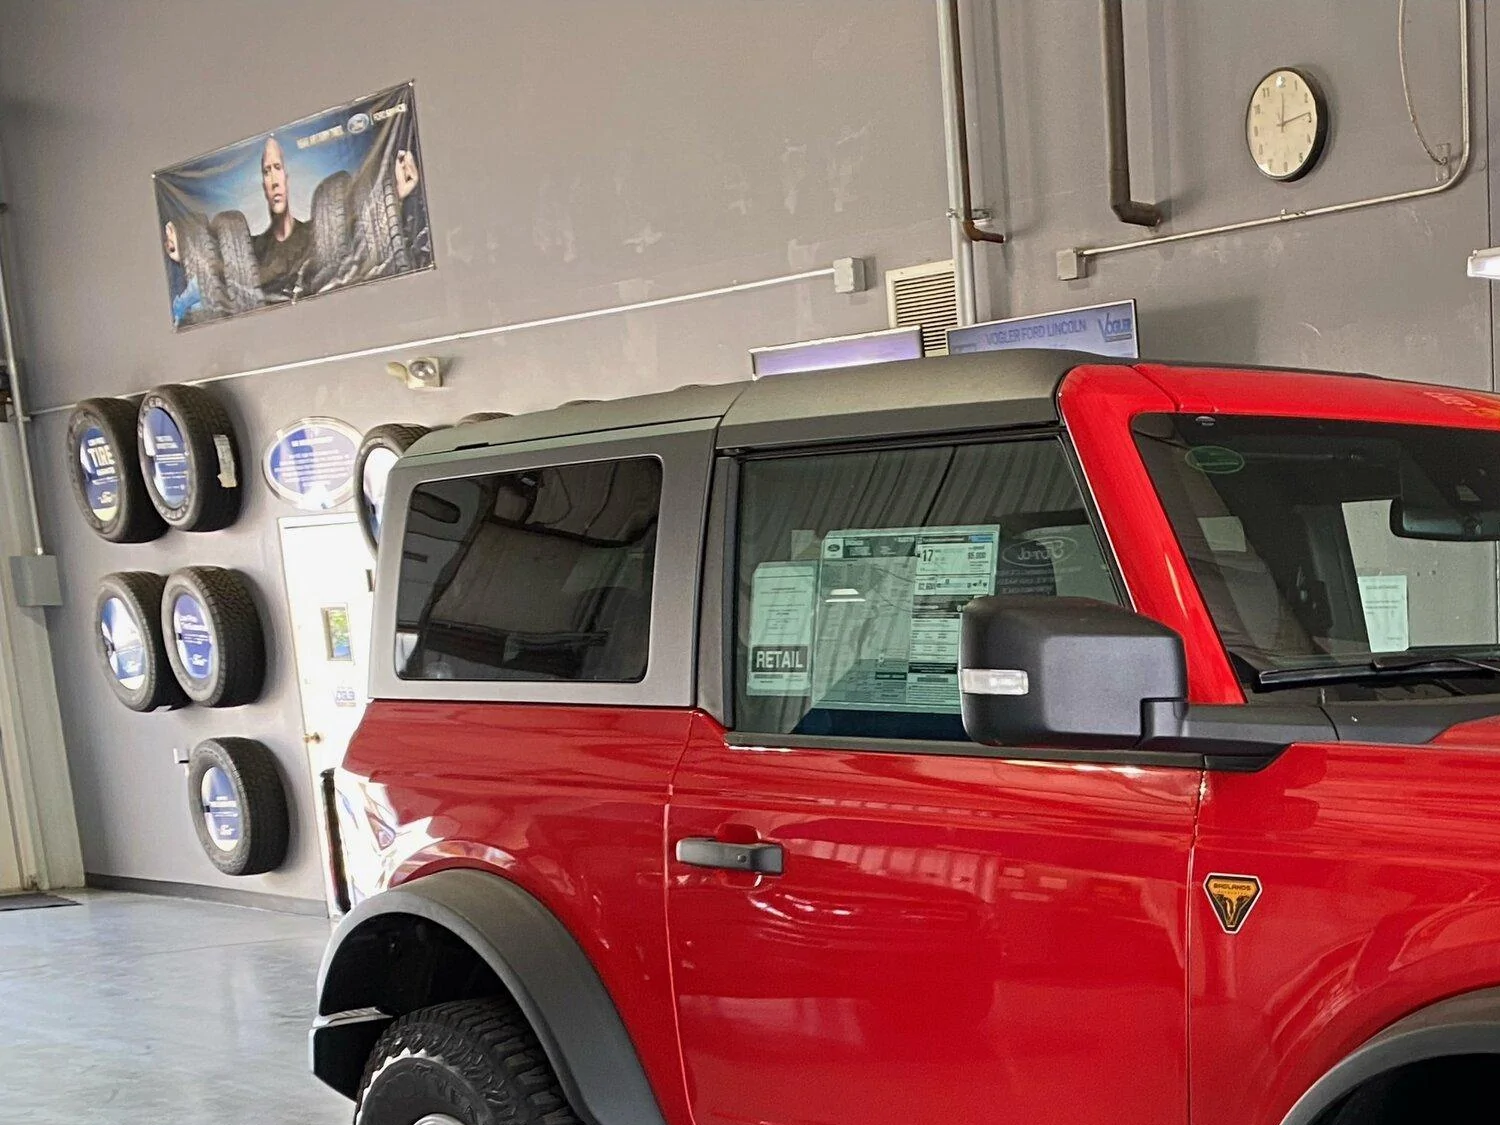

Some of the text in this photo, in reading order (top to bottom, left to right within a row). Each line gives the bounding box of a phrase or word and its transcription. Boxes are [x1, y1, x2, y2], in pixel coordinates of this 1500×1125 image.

[1022, 324, 1045, 340] FORD
[1046, 319, 1087, 337] LINCOLN
[922, 549, 934, 562] 17
[756, 651, 804, 668] RETAIL
